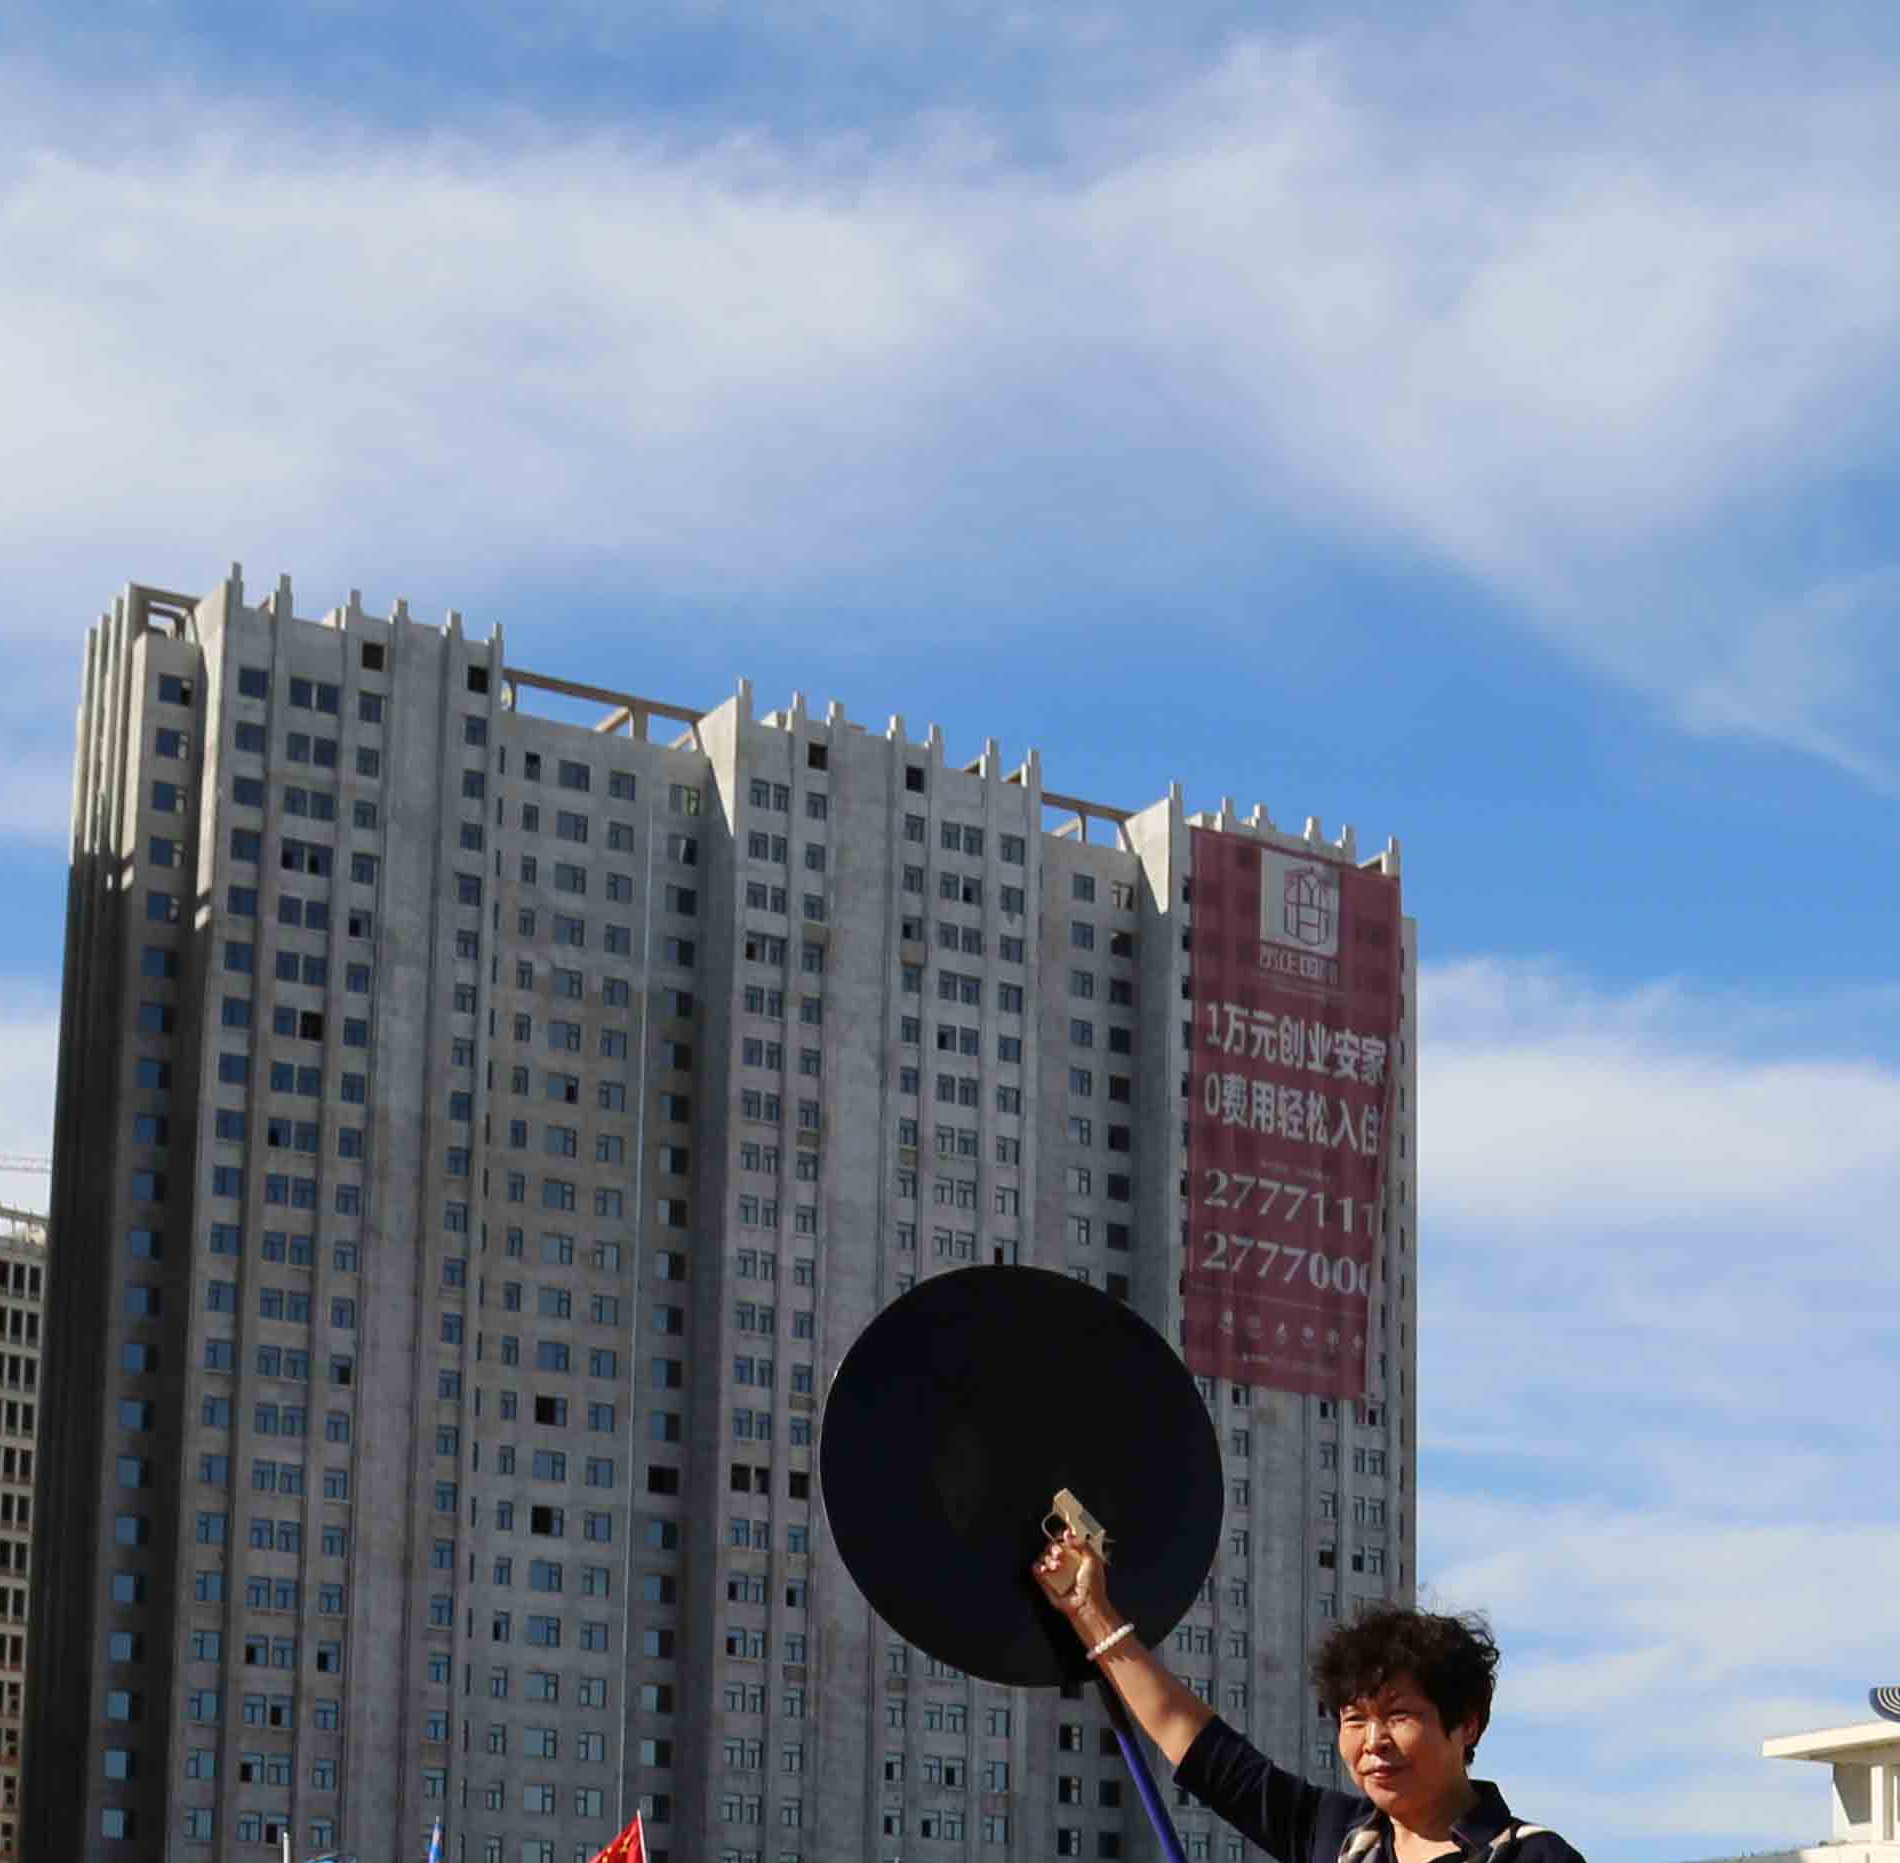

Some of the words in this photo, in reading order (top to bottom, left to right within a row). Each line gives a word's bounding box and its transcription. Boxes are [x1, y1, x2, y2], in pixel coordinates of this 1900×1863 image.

[1205, 1000, 1387, 1087] 1万元创业安家
[1203, 1072, 1381, 1155] 0费用轻松入住
[1203, 1168, 1373, 1237] 2777111
